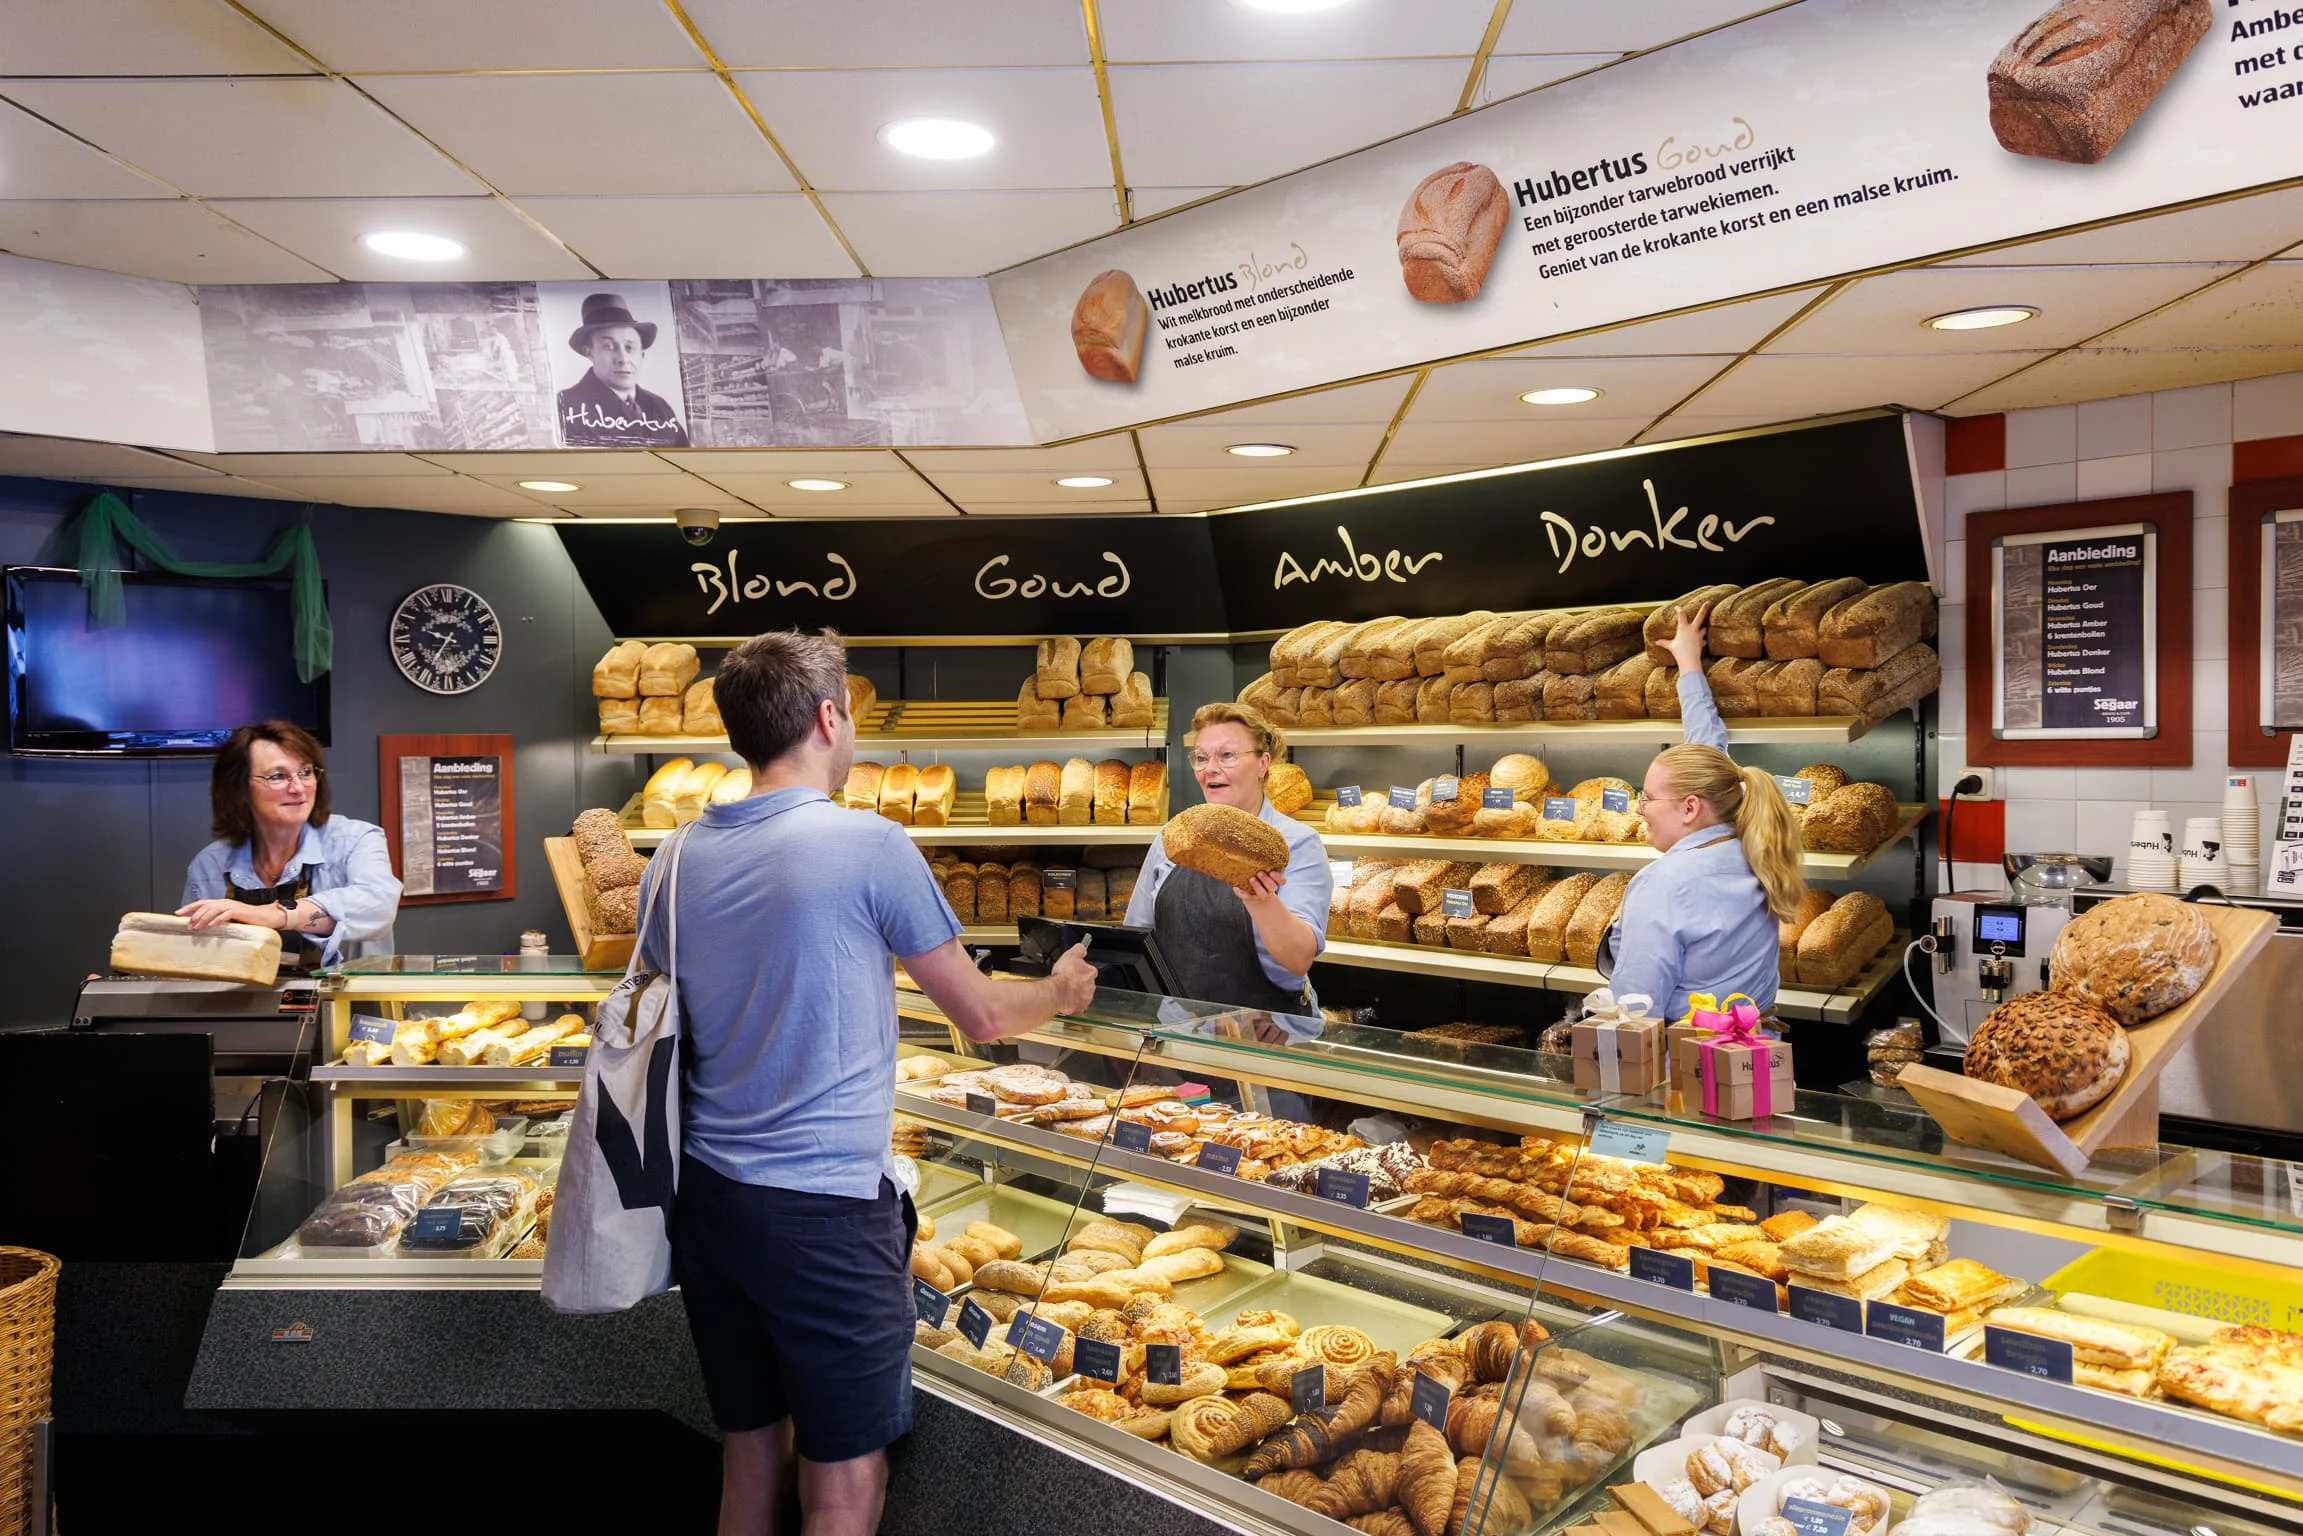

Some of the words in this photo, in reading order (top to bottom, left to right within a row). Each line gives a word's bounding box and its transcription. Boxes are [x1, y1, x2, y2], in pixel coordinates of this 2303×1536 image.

[2234, 46, 2286, 76] met
[1513, 151, 1648, 208] Hubertus
[1656, 116, 1756, 171] Goud
[1523, 215, 1553, 232] Een
[1554, 194, 1625, 225] bijzonder
[1628, 163, 1727, 203] tarwebrood
[1729, 146, 1796, 177] verrijkt
[1531, 237, 1562, 256] met
[1564, 211, 1658, 251] geroosterde
[1660, 183, 1779, 223] tarwekiemen.
[1539, 256, 1588, 279] Geniet
[1590, 250, 1618, 267] van
[1621, 243, 1642, 259] de
[1643, 226, 1718, 254] krokante
[1720, 212, 1766, 235] korst
[1769, 208, 1791, 223] en
[1795, 198, 1829, 217] een
[1833, 183, 1891, 209] malse
[1894, 168, 1959, 193] kruim.
[1147, 271, 1238, 311] Hubertus
[1239, 243, 1307, 291] Blond
[1158, 315, 1178, 330] Wit
[1179, 299, 1234, 325] melkbrood
[1234, 295, 1257, 310] met
[1258, 267, 1355, 304] onderscheidende
[1165, 330, 1211, 350] krokante
[1212, 321, 1240, 338] korst
[1241, 318, 1255, 330] en
[1256, 313, 1277, 327] een
[1278, 299, 1330, 322] bijzonder
[1173, 350, 1205, 369] malse
[1205, 344, 1239, 362] kruim.
[565, 402, 679, 432] Hubertus
[691, 552, 857, 615] Blond
[975, 552, 1130, 599] Goud
[1273, 525, 1443, 590] Amber
[1540, 478, 1775, 575] Donker
[2047, 545, 2136, 563] Aanbieding
[2047, 585, 2081, 593] Hubertus
[2047, 603, 2081, 611] Hubertus
[2082, 601, 2104, 609] Goud
[2047, 621, 2081, 629] Hubertus
[2082, 619, 2108, 628] Amber
[2047, 650, 2081, 658] Hubertus
[2082, 648, 2110, 656] Donker
[2094, 698, 2138, 711] Segaar
[433, 762, 493, 773] Aanbieding
[1889, 1313, 1916, 1326] VEGAN
